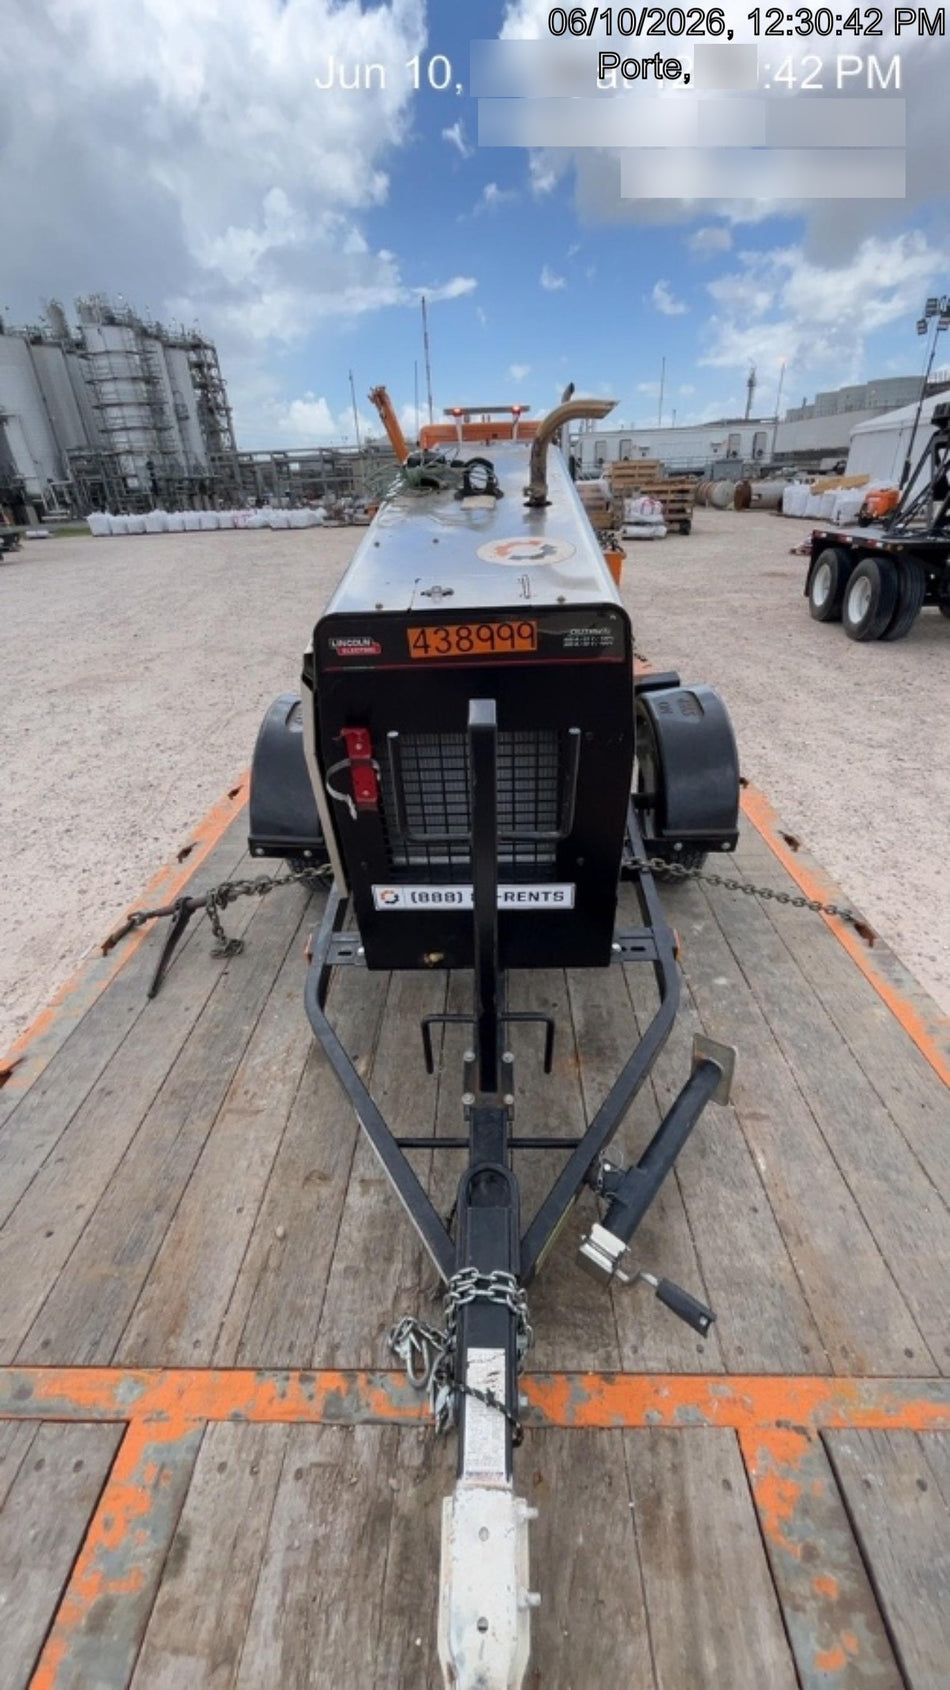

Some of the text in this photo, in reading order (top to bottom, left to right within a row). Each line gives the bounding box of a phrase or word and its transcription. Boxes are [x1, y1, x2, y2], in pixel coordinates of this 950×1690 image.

[412, 623, 535, 654] 438999
[411, 891, 565, 904] (888) -RENTS
